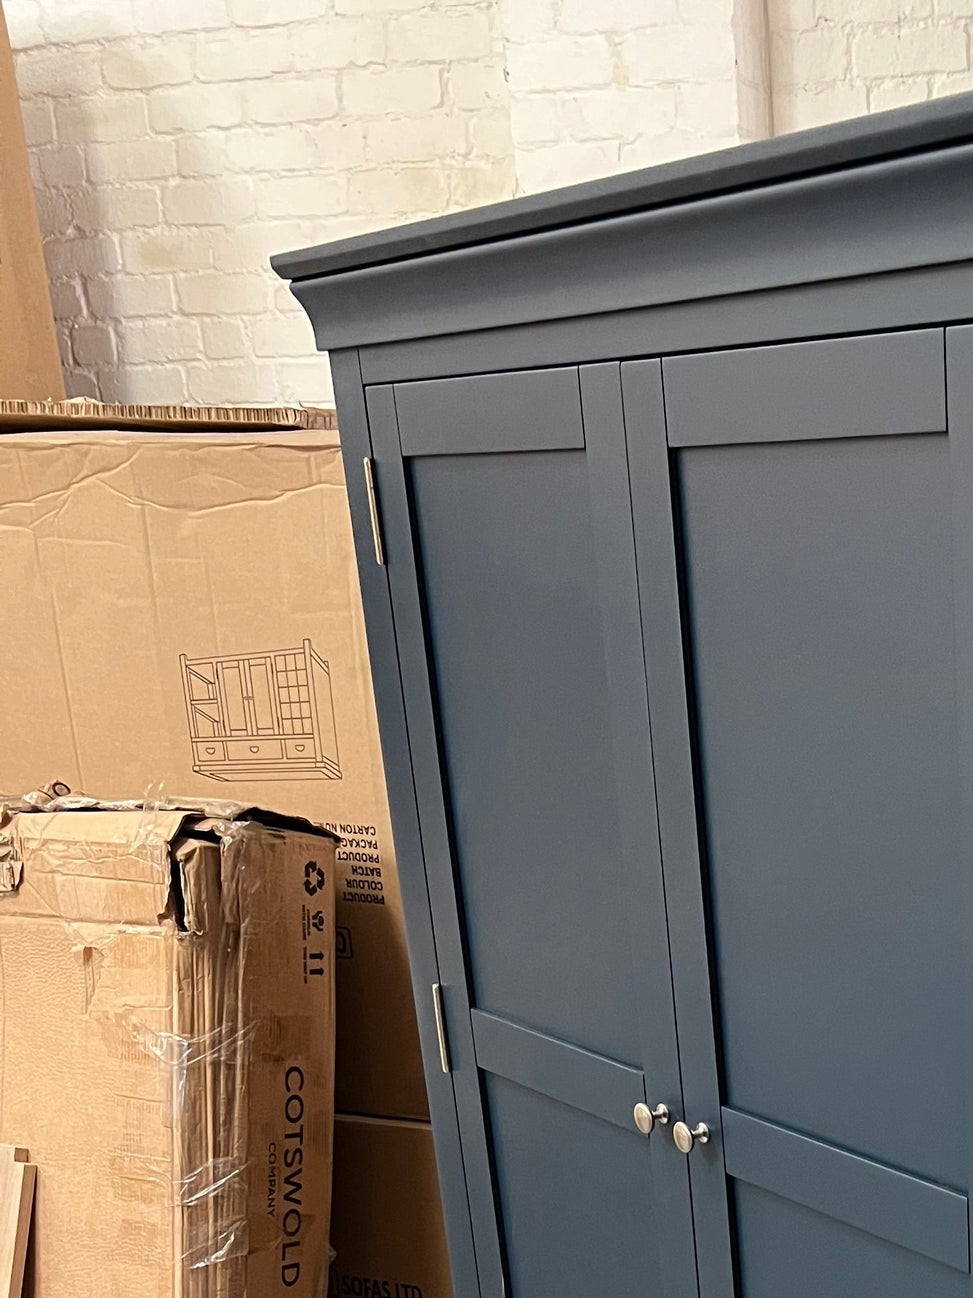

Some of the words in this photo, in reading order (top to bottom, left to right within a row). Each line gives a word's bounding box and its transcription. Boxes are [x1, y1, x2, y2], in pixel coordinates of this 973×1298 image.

[340, 824, 376, 836] CARTON
[337, 851, 379, 863] PRODUCT
[351, 865, 381, 877] BATCH
[346, 878, 383, 891] COLOUR
[343, 891, 385, 905] PRODUCT
[267, 1142, 277, 1217] COMPANY
[281, 1066, 304, 1287] COTSWOLD
